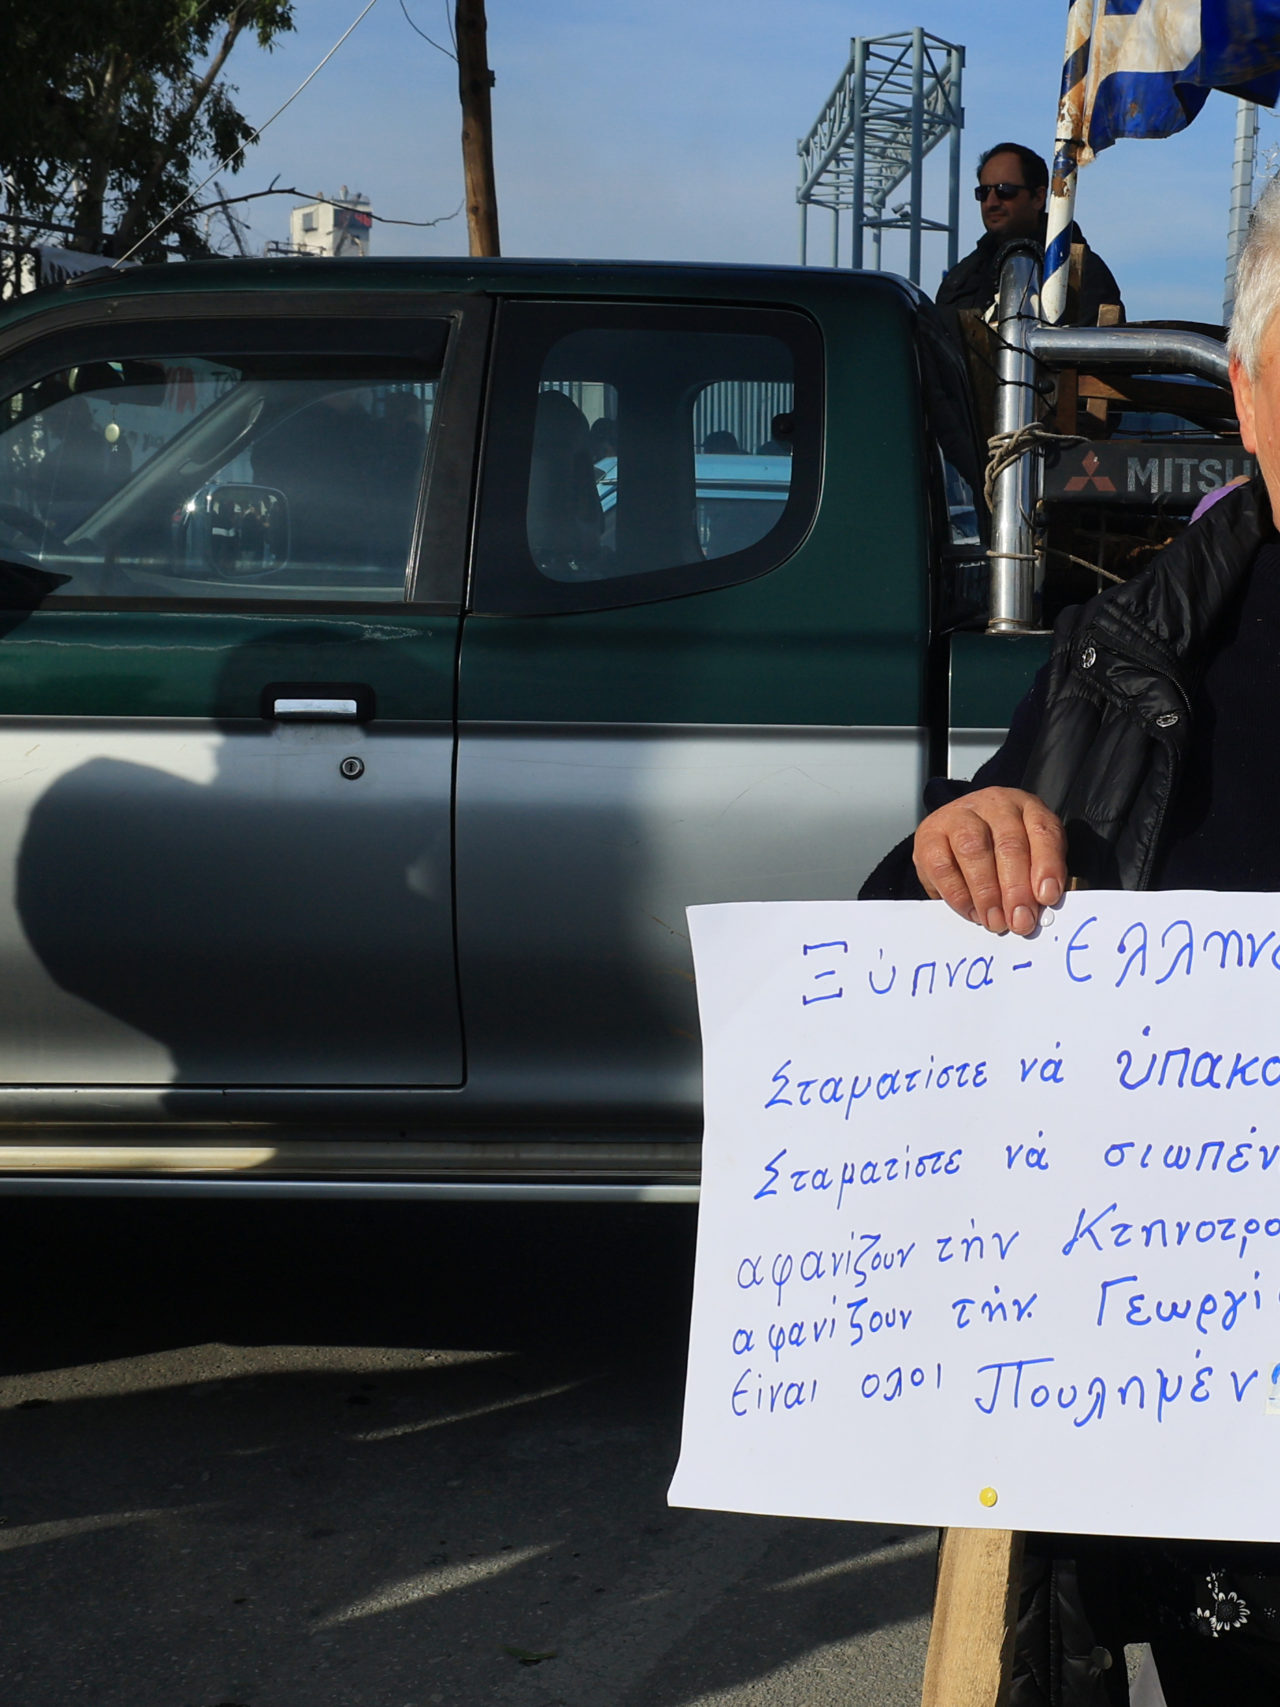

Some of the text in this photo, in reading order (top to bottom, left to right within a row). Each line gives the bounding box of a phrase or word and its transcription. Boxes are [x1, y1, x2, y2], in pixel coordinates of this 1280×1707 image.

[1126, 457, 1260, 494] MITSU
[1019, 1040, 1066, 1084] νά
[1005, 1129, 1050, 1170] νά
